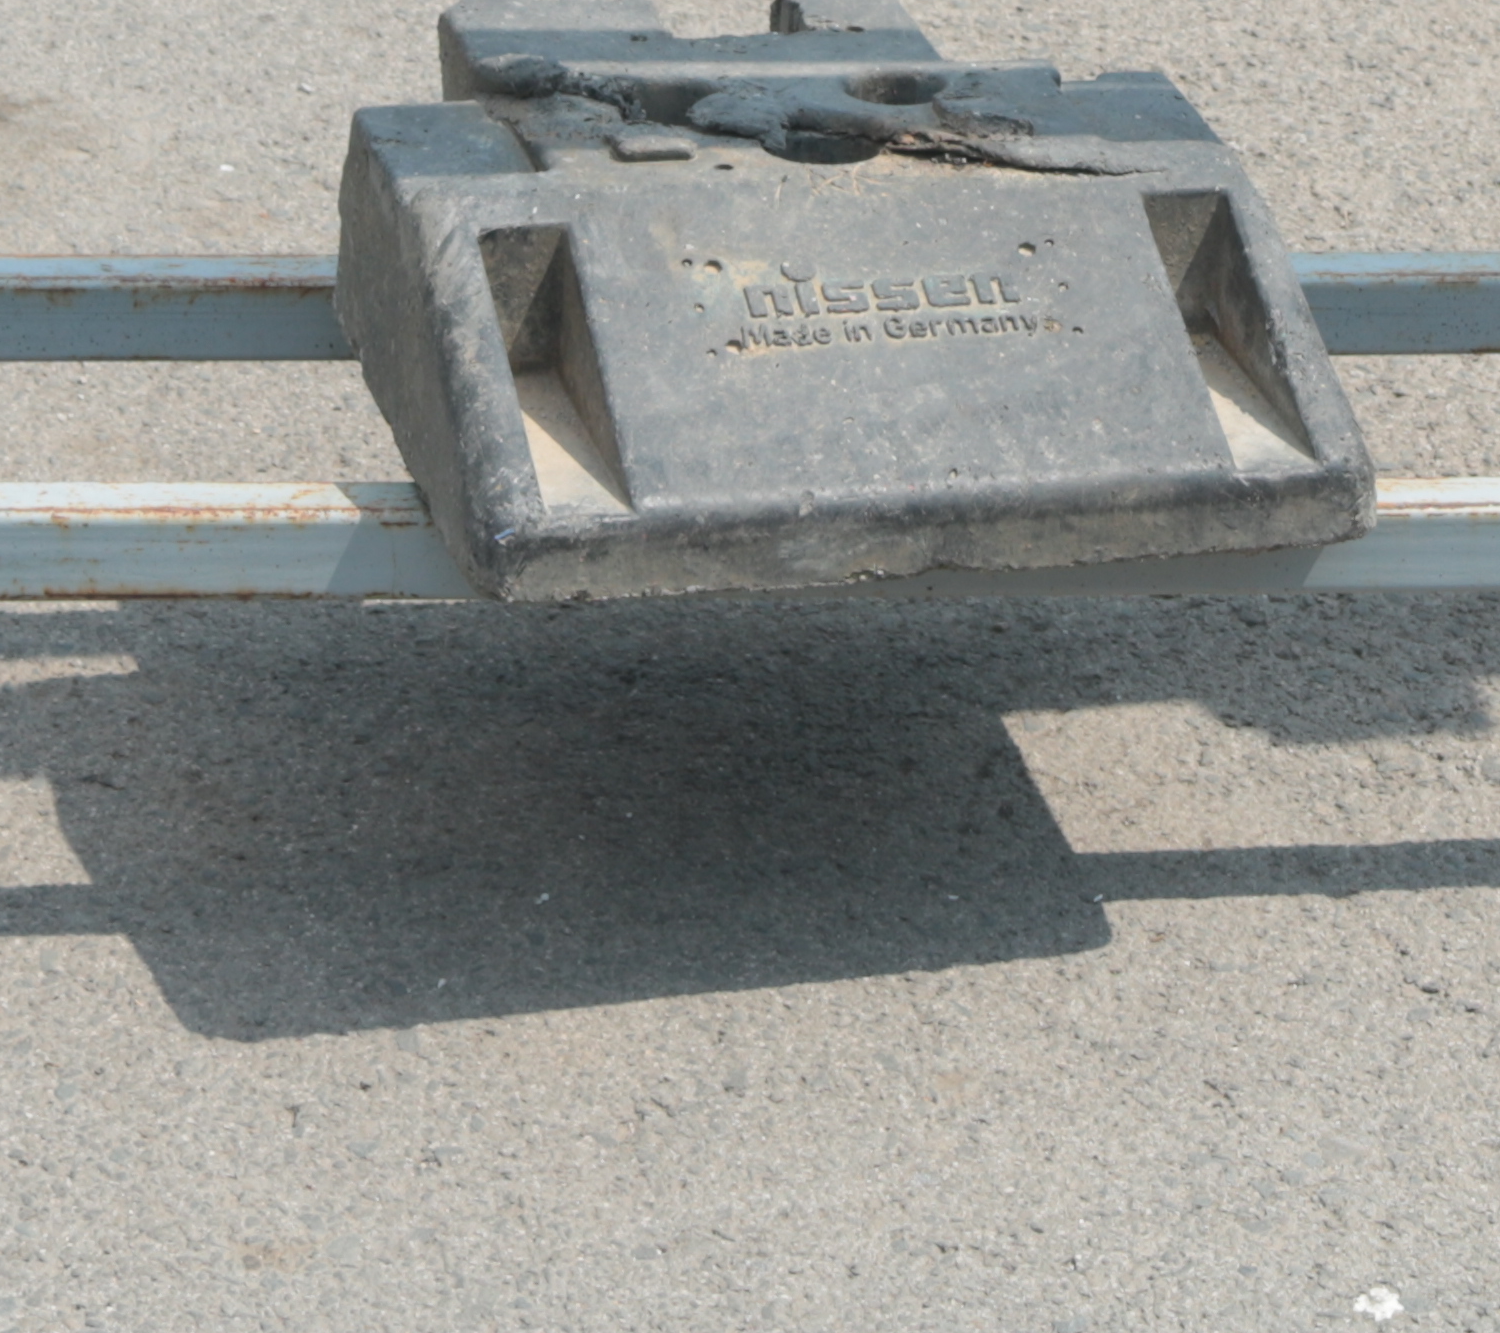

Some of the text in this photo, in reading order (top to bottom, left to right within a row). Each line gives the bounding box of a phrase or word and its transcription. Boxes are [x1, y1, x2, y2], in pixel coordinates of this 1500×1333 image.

[741, 314, 1038, 348] Made in Germany
